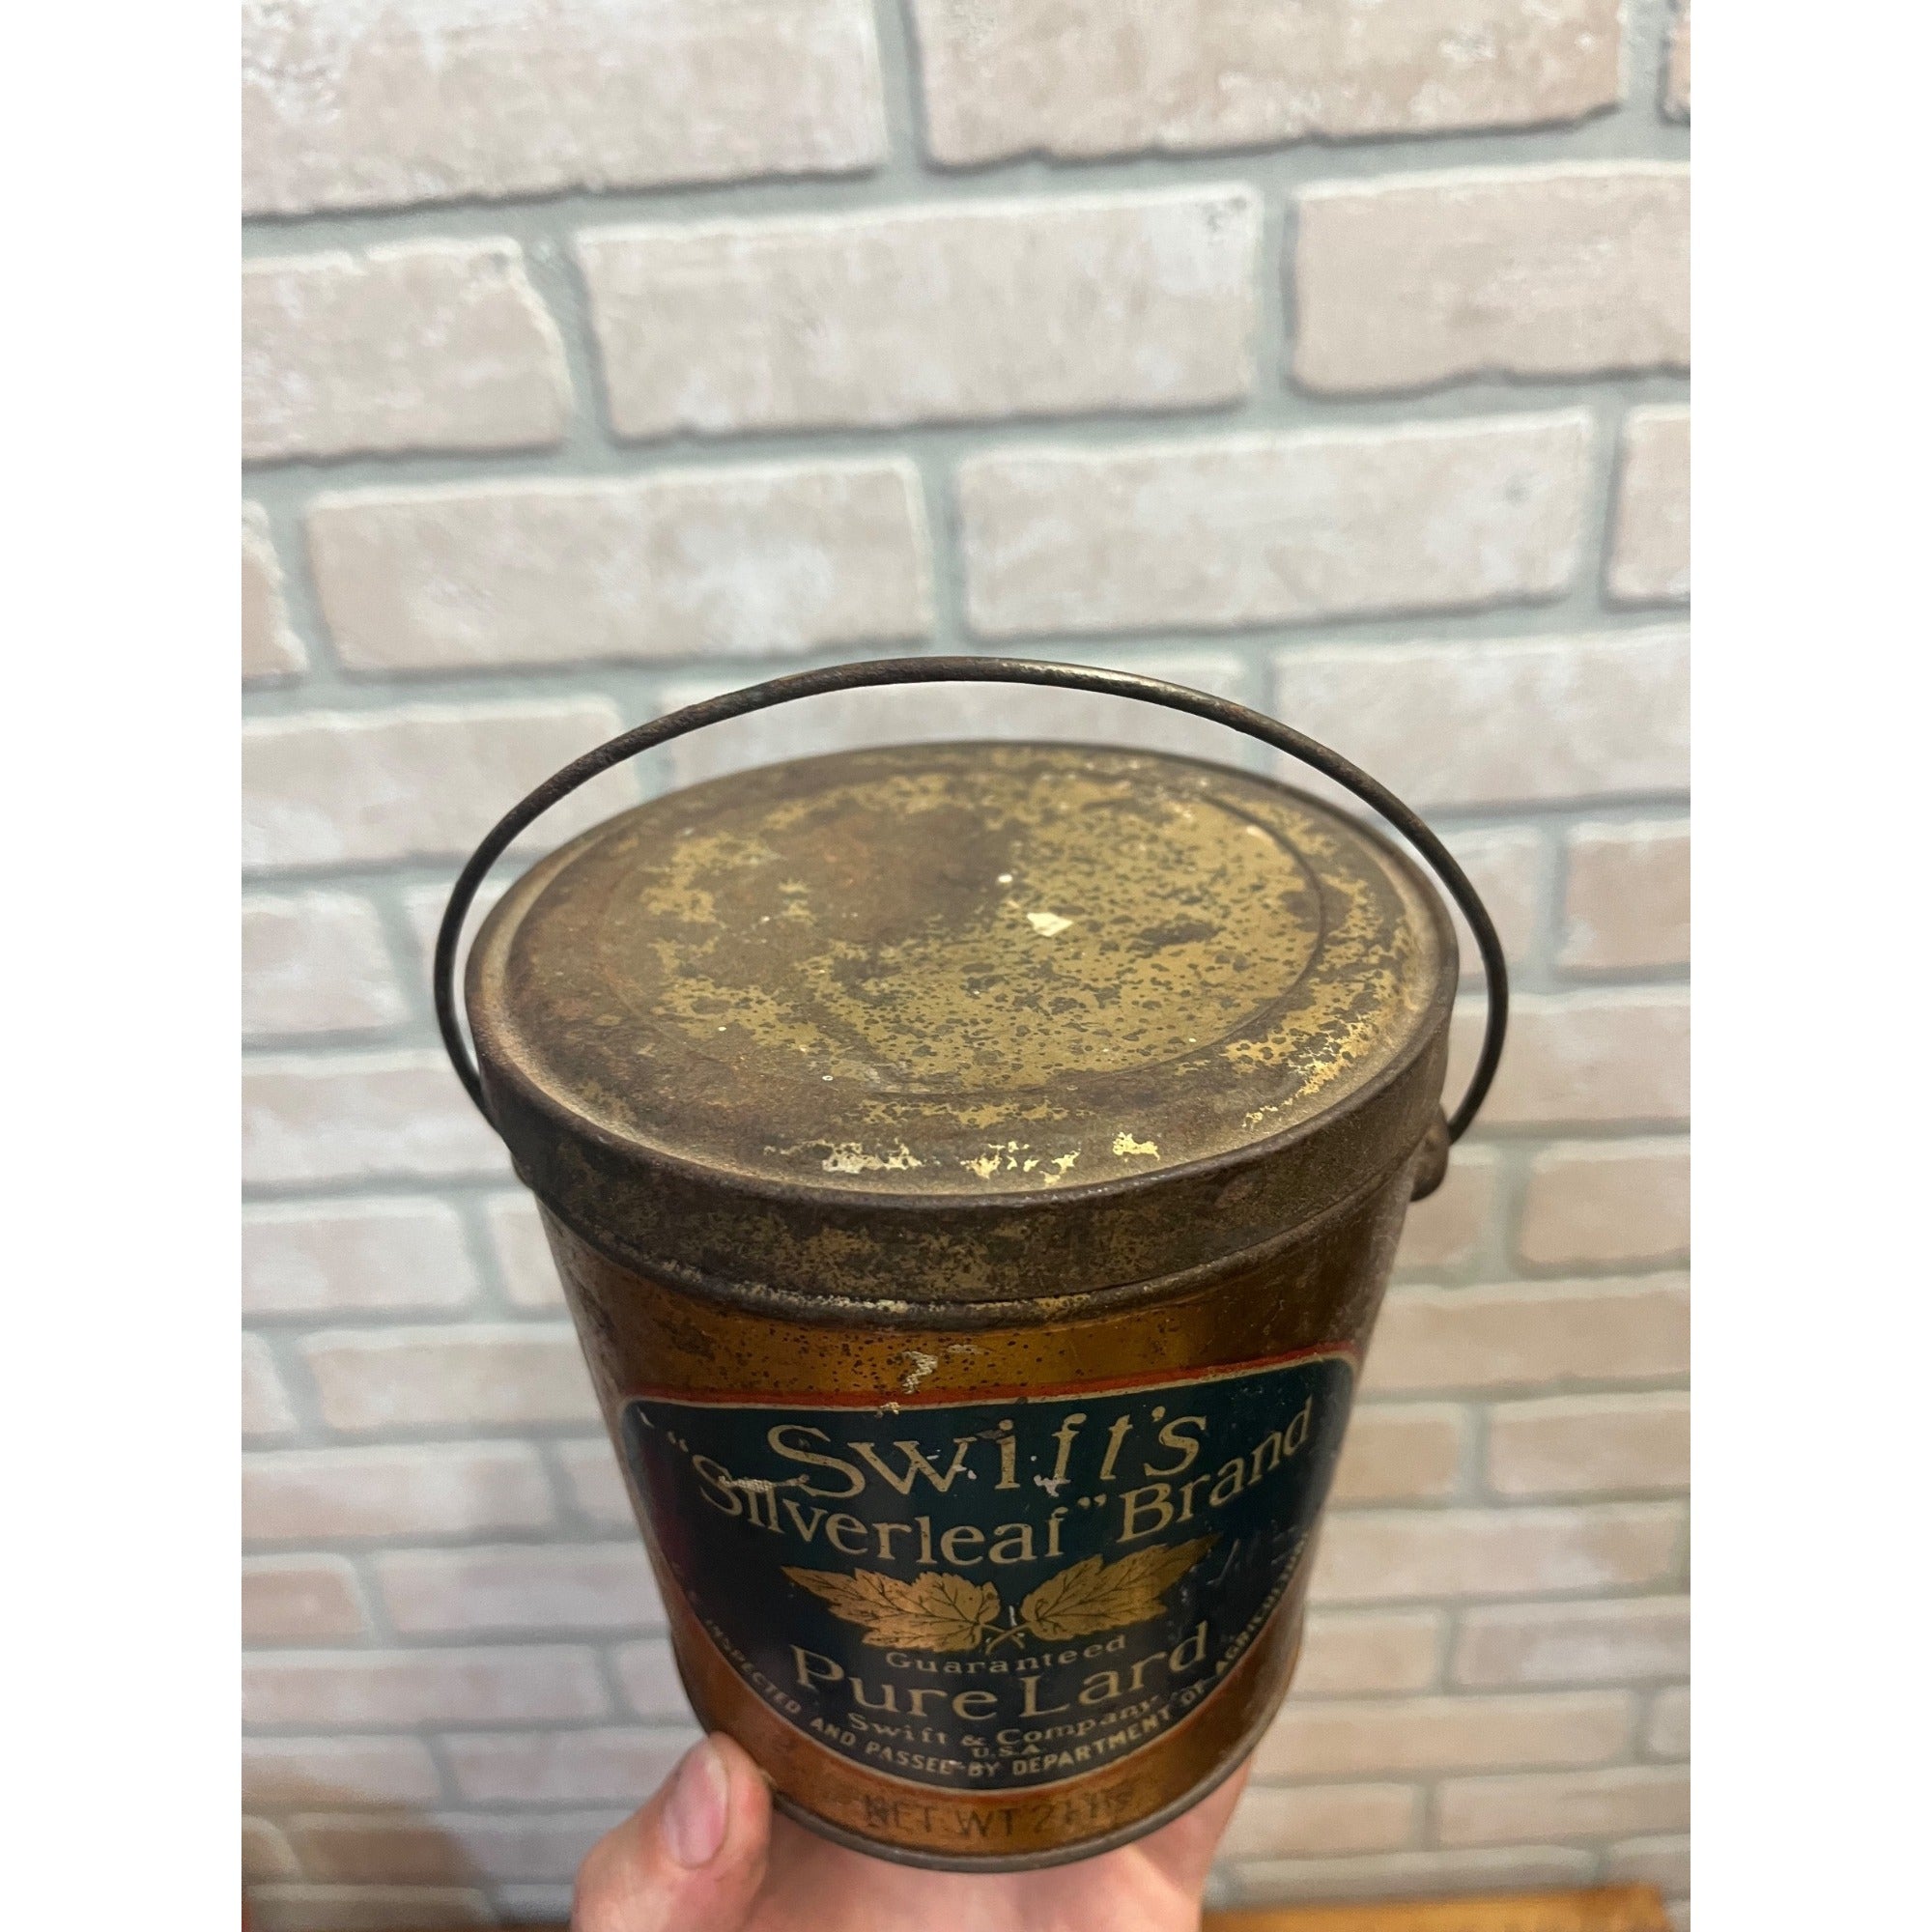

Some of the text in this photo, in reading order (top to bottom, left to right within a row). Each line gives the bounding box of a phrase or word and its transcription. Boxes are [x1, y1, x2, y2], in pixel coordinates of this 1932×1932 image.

[767, 1406, 1208, 1498] Swift's
[1116, 1395, 1313, 1544] Brand
[789, 1620, 1208, 1720] Pure Lard
[885, 1634, 1126, 1675] Guaranteed
[810, 1716, 857, 1747] AND
[1011, 1703, 1171, 1776] DEPARTMENT
[846, 1711, 951, 1746] Swift
[960, 1733, 985, 1748] &
